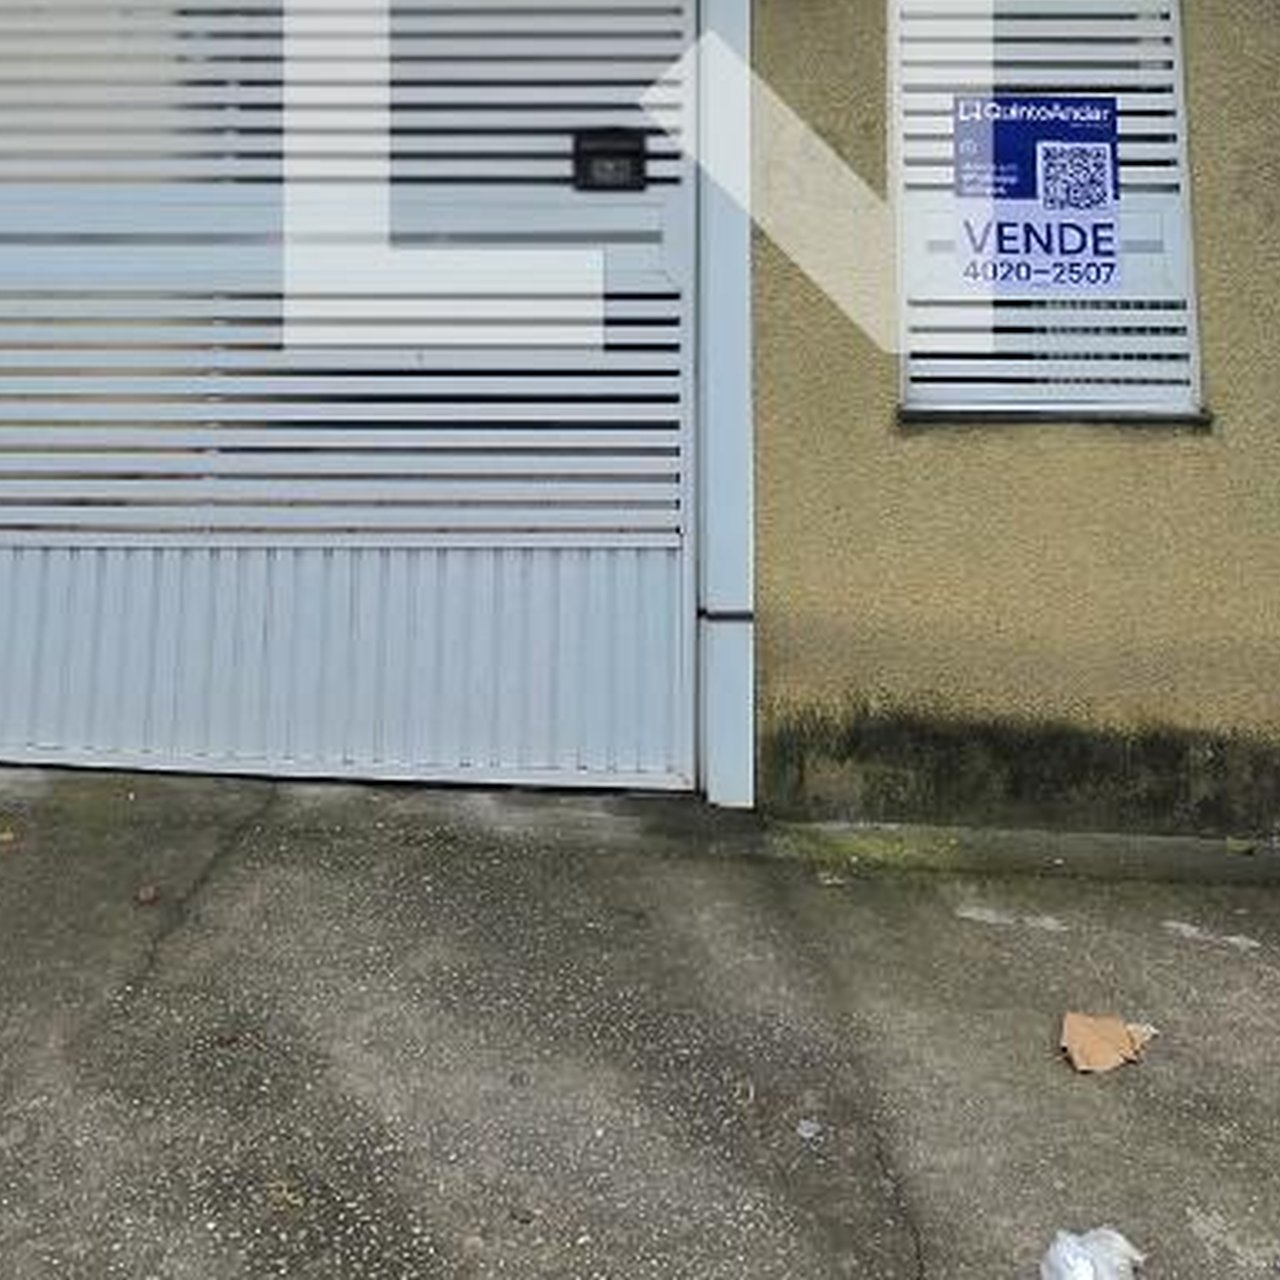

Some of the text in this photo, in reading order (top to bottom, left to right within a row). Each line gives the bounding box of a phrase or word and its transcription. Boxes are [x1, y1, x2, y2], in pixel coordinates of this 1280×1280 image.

[983, 101, 1111, 121] QuintoAndar
[964, 221, 1115, 257] VENDE
[963, 261, 1116, 285] 4020-2507
